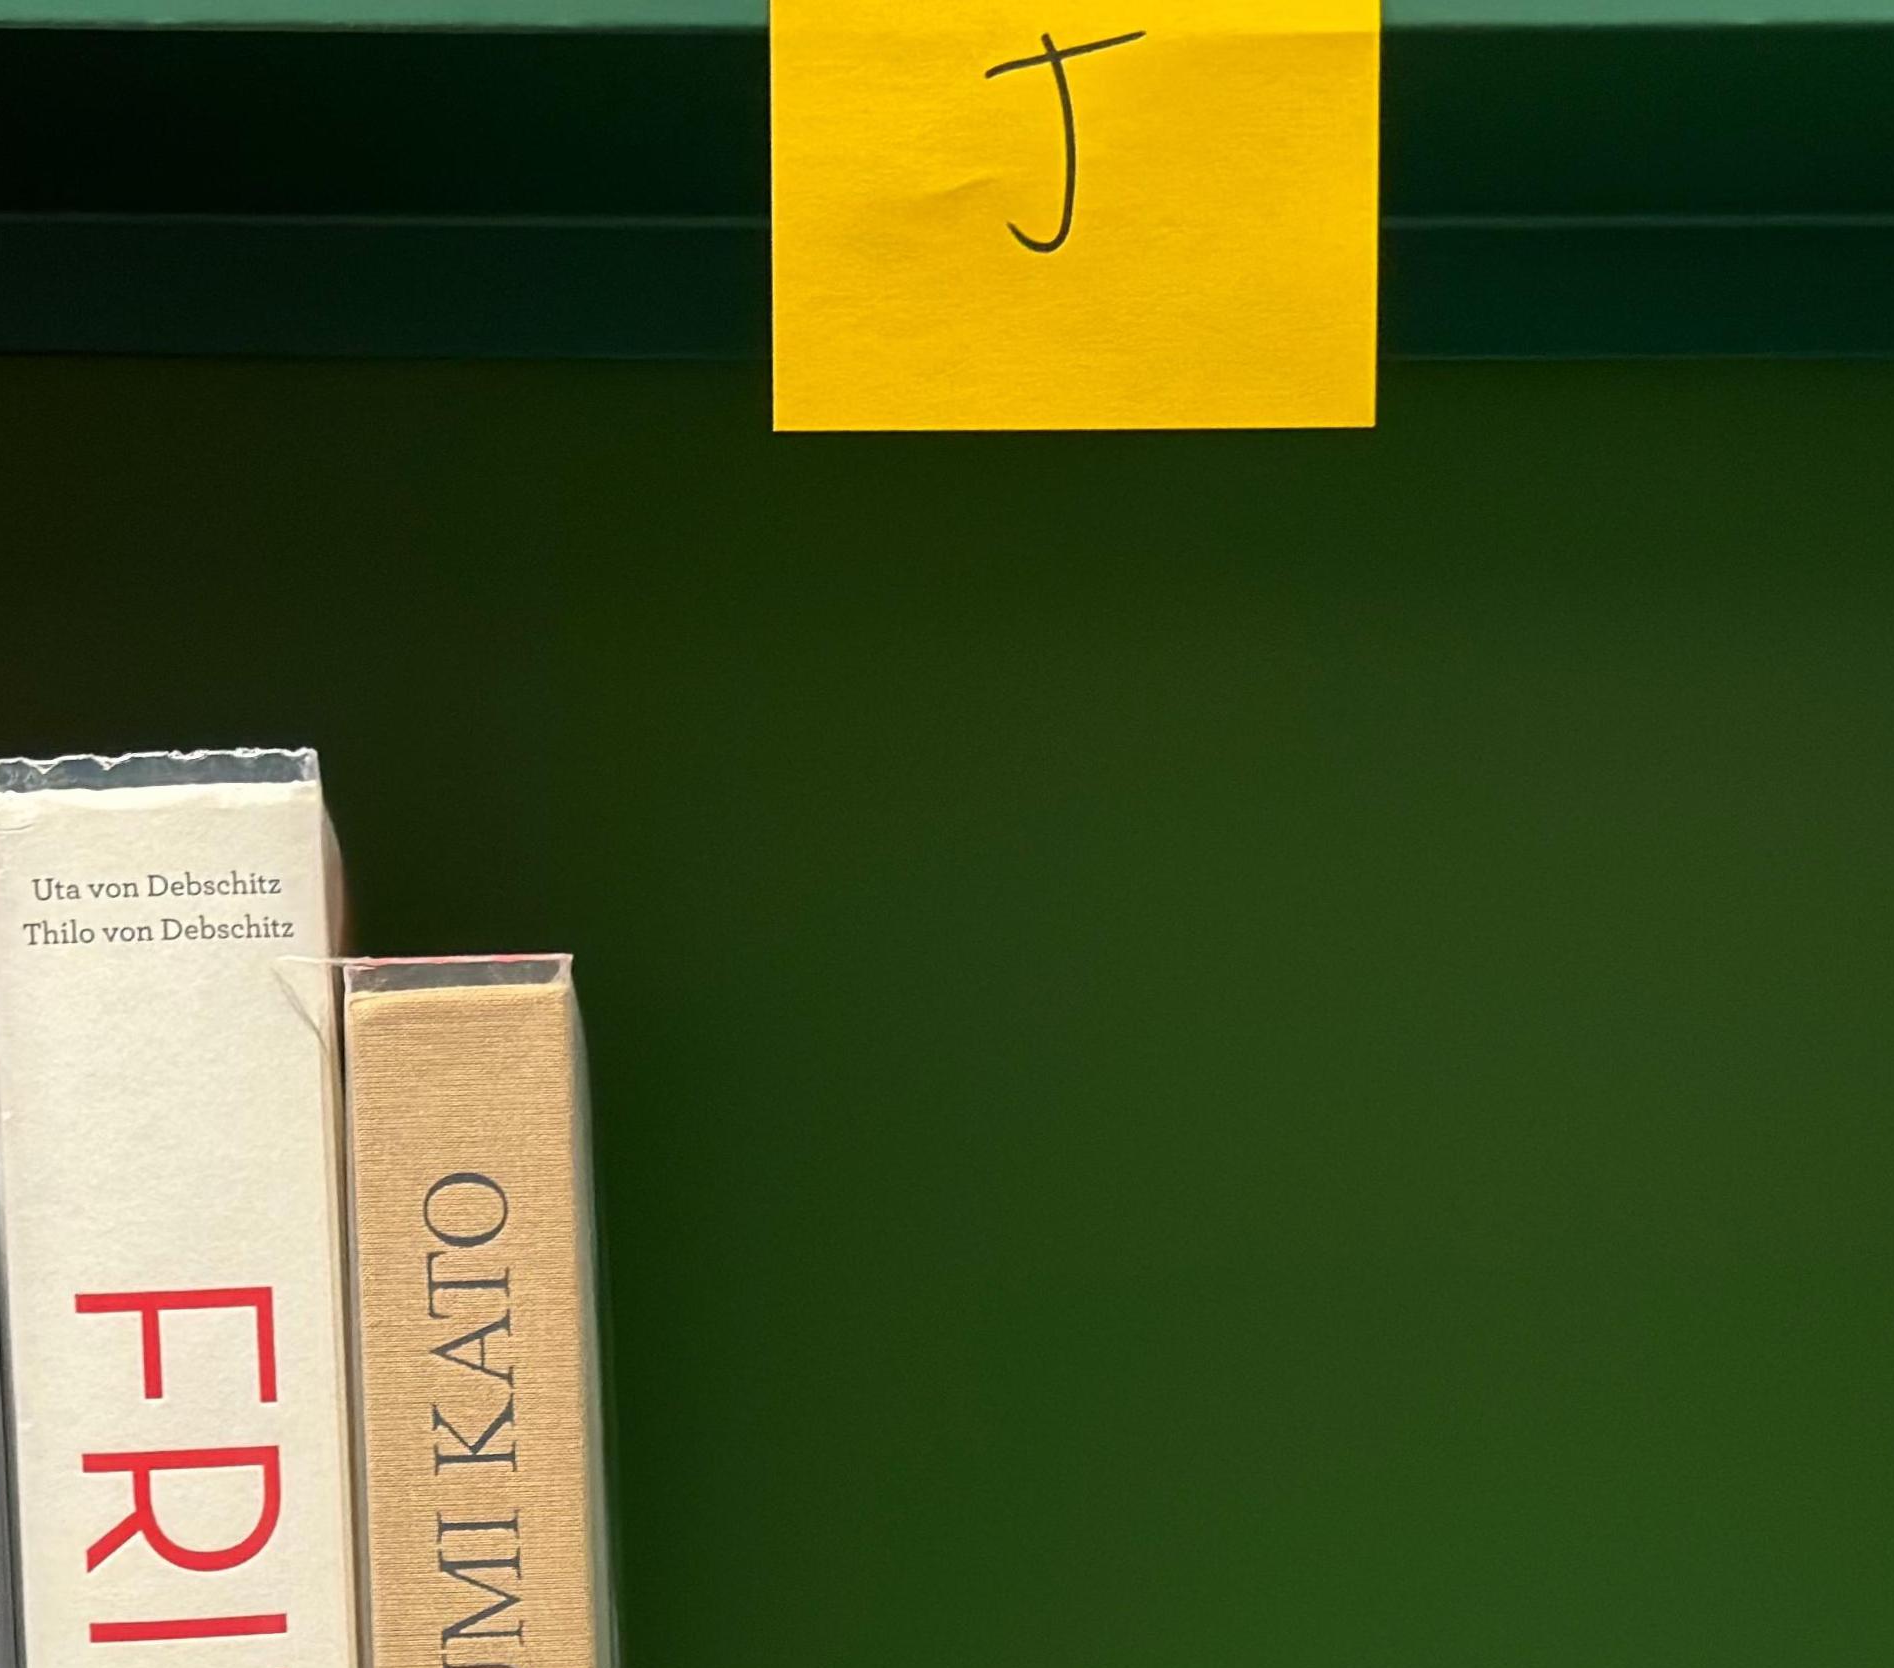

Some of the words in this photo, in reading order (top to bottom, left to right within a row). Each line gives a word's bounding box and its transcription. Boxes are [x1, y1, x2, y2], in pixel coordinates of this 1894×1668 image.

[985, 31, 1146, 253] J
[23, 919, 95, 946] Thilo
[102, 920, 153, 943] von
[160, 913, 295, 942] Debschitz
[32, 877, 81, 902] Uta
[87, 877, 139, 900] von
[147, 870, 282, 899] Debschitz
[422, 1171, 518, 1476] KATO
